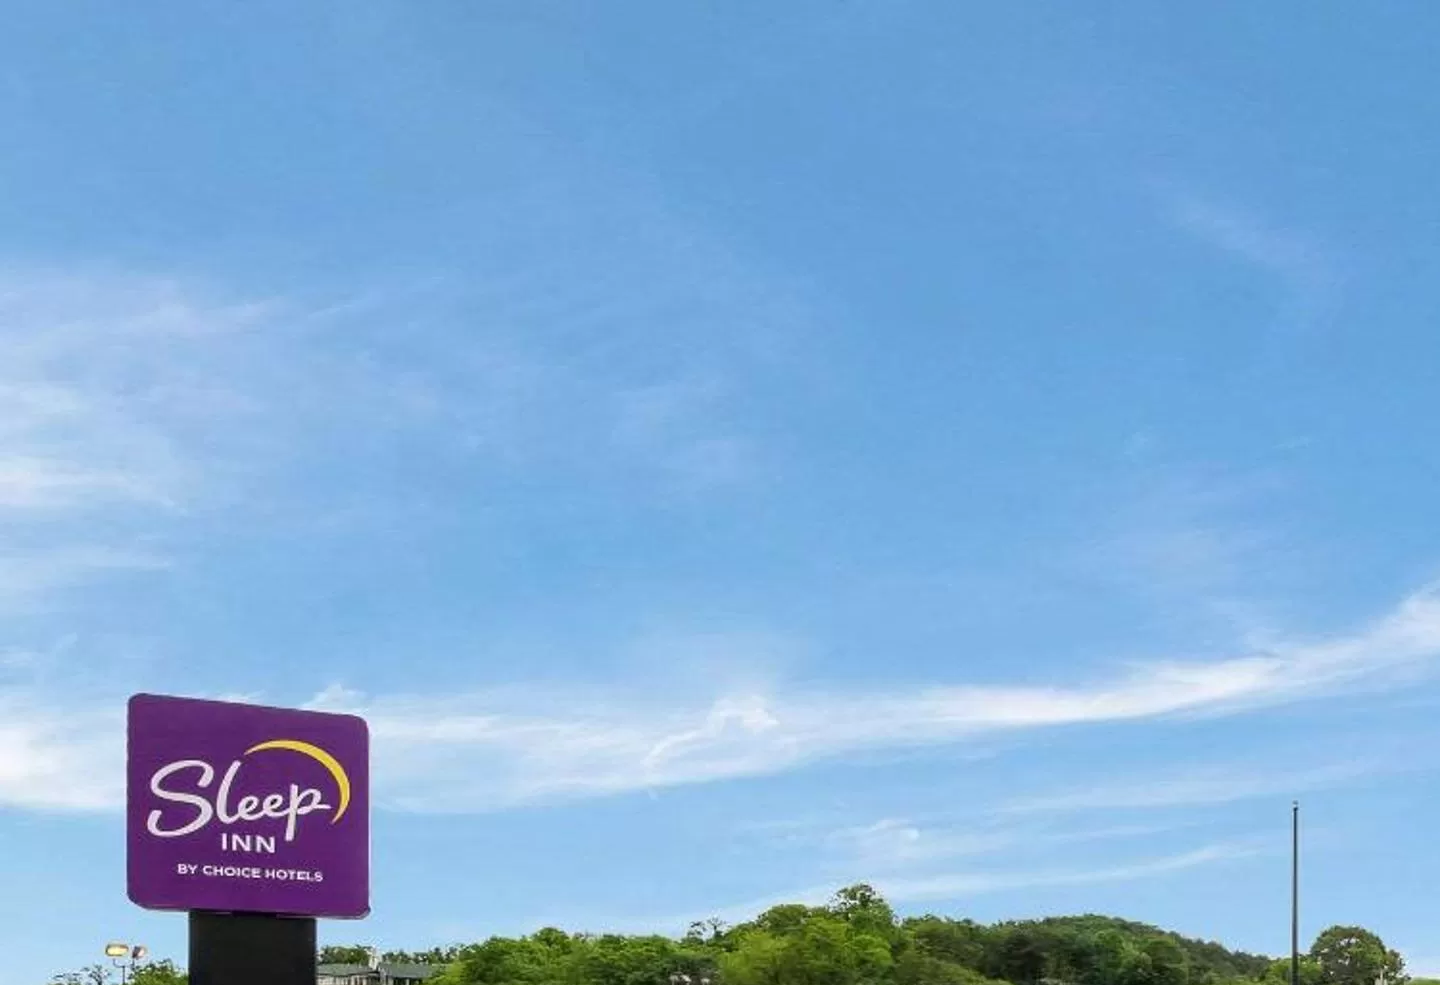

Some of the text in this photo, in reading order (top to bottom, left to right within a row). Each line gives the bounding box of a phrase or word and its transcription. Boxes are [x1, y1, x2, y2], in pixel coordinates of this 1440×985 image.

[147, 760, 332, 841] Sleep
[221, 832, 276, 853] INN
[177, 863, 324, 882] BY CHOICE HOTELS
